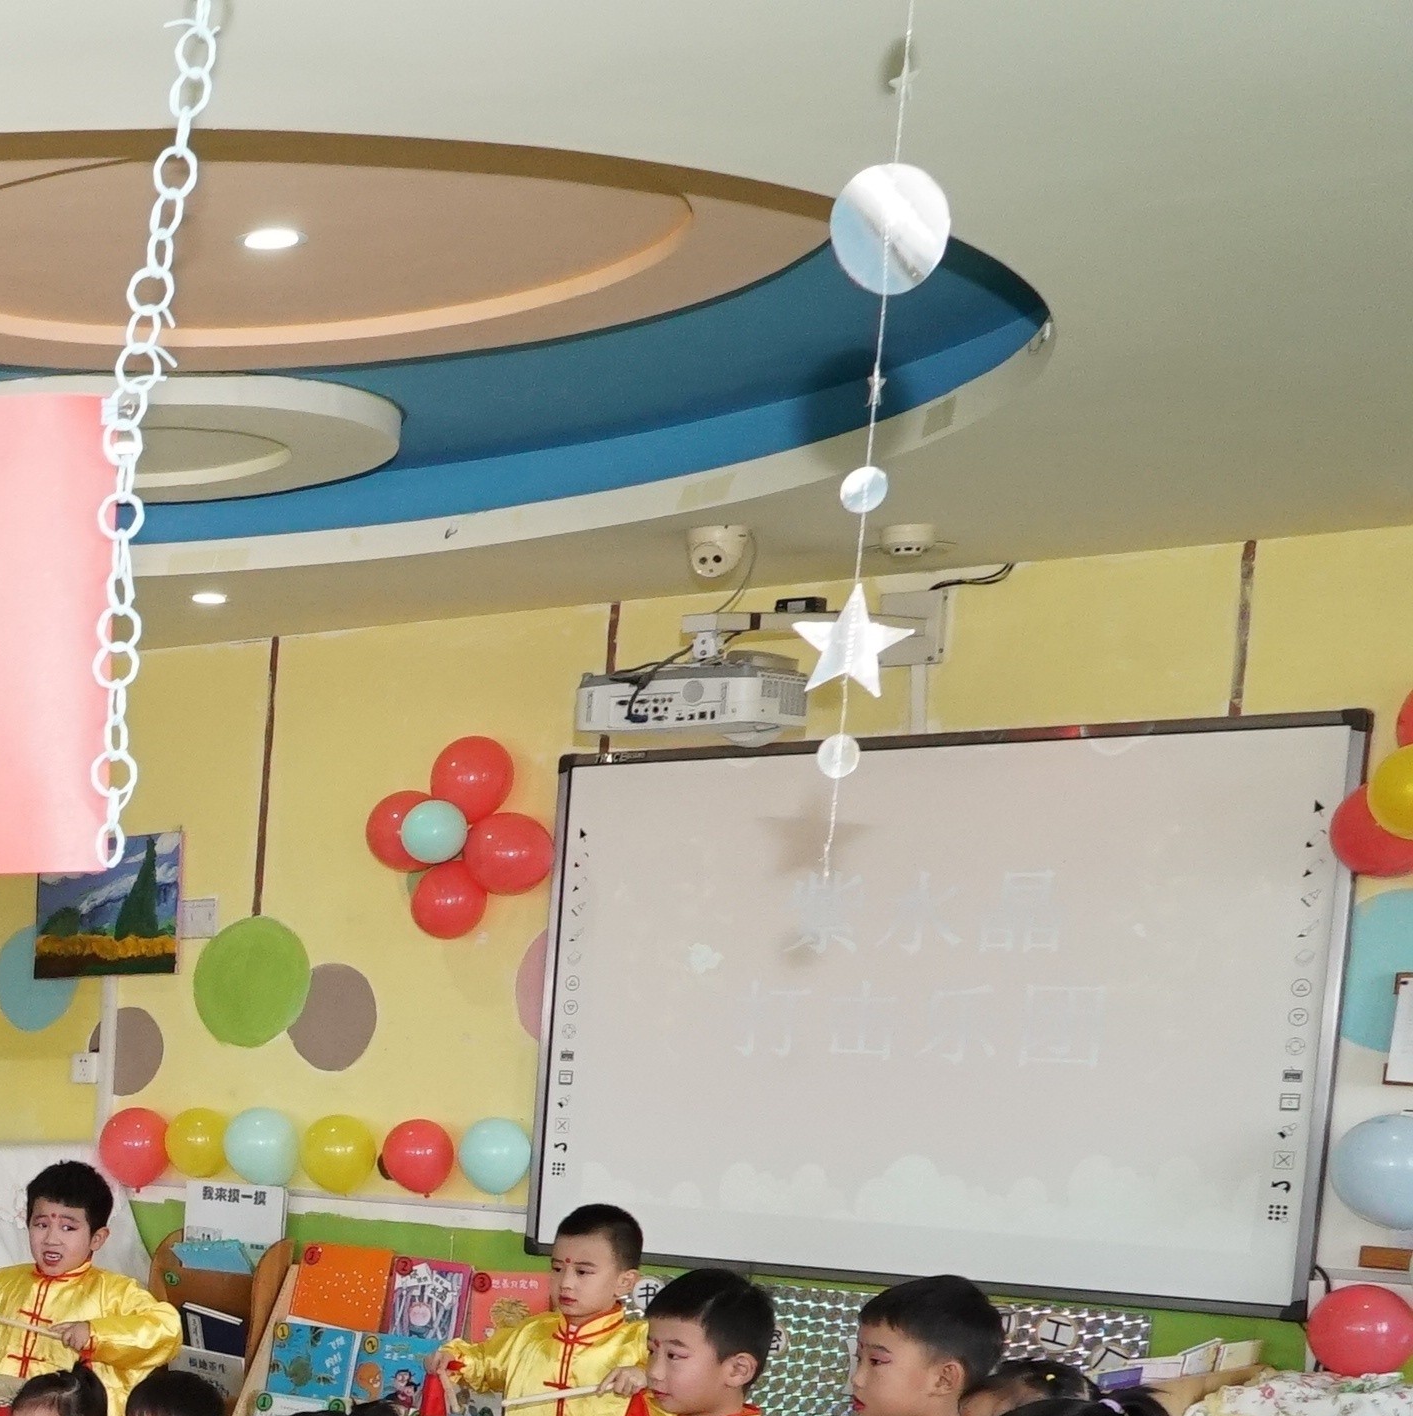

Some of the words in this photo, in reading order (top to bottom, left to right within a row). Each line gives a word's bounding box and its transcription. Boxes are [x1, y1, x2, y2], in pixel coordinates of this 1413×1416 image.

[201, 1185, 268, 1206] 我来摸一摸
